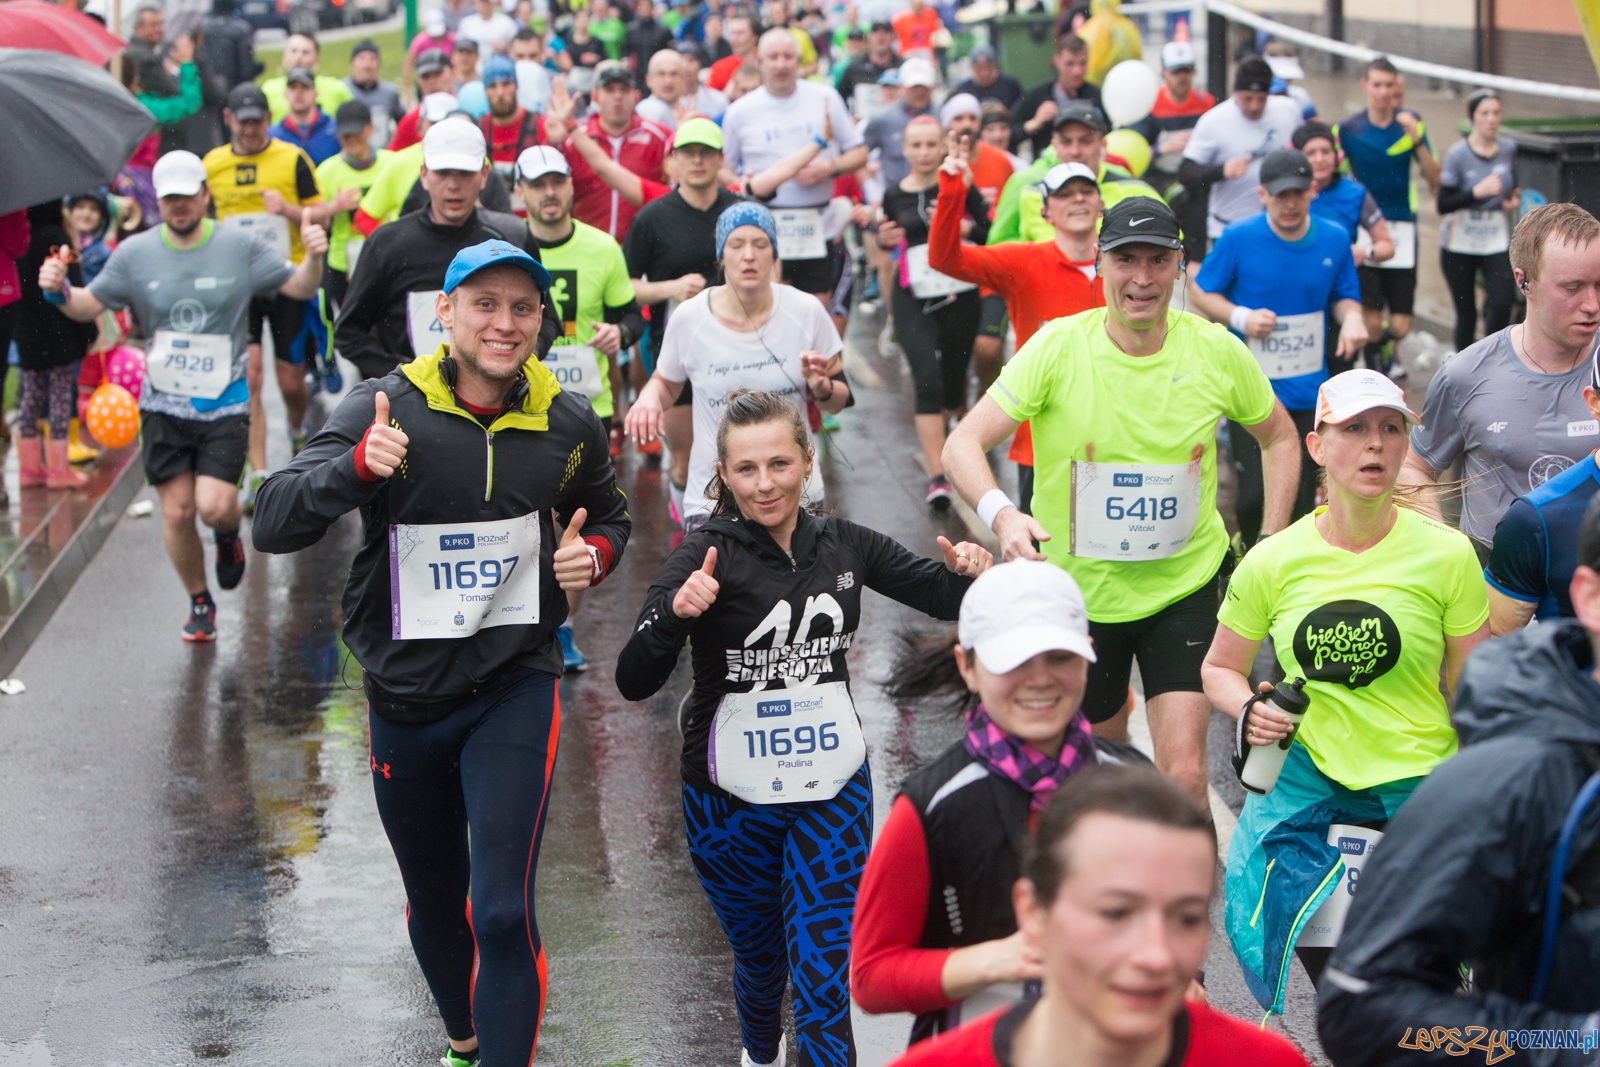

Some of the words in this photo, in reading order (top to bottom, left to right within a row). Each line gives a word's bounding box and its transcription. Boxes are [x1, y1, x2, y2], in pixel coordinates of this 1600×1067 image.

[1261, 333, 1315, 353] 10524
[164, 354, 214, 373] 7928
[1486, 421, 1508, 433] 4F
[1106, 496, 1178, 521] 6418
[1128, 524, 1156, 532] Witold
[428, 555, 520, 590] 11697
[1306, 617, 1384, 651] biegiem
[1314, 641, 1388, 671] pomoc
[743, 721, 840, 758] 11696
[777, 759, 813, 768] Paulina
[804, 780, 820, 789] 4F
